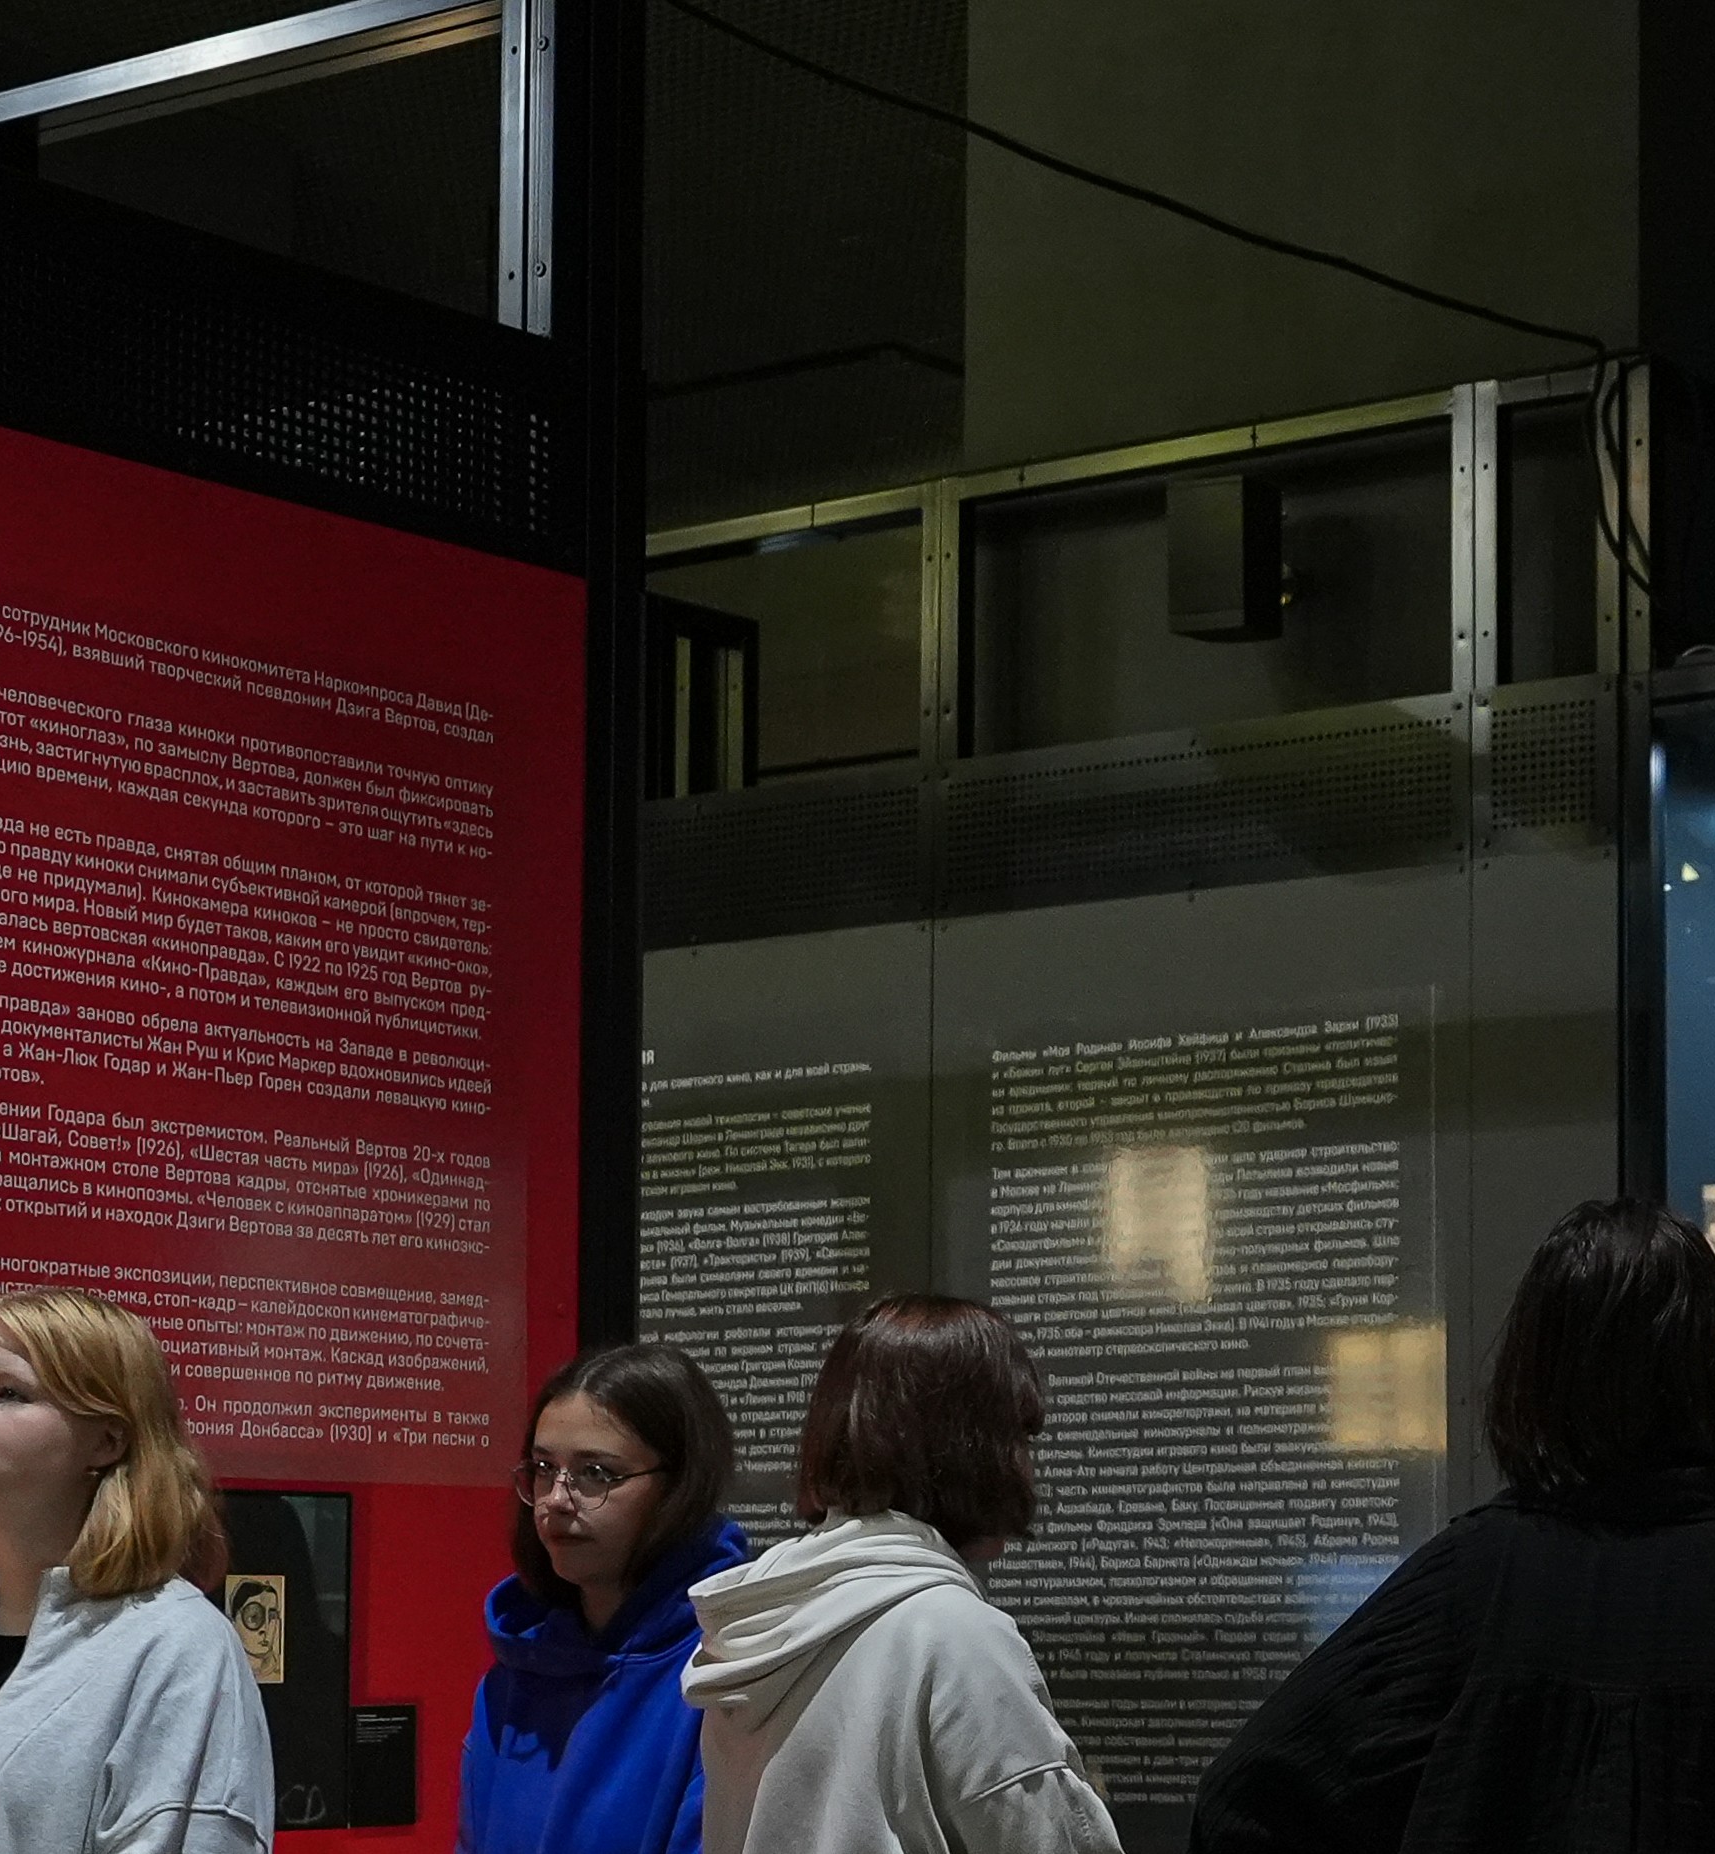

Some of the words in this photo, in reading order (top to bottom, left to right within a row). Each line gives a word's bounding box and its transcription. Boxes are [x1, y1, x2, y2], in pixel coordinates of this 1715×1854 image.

[1, 605, 90, 636] сотрудник
[94, 622, 198, 659] Московского
[201, 649, 310, 683] кинокомитета
[314, 669, 413, 706] Наркомпроса
[415, 692, 462, 718] Давид
[72, 643, 144, 670] взявший
[148, 660, 241, 691] творческий
[246, 681, 331, 710] псевдоним
[335, 696, 380, 720] Дзига
[384, 706, 439, 734] Вертов,
[443, 722, 493, 743] создал
[76, 1005, 135, 1025] заново
[141, 1012, 198, 1033] обрела
[204, 1022, 310, 1048] актуальность
[315, 1038, 333, 1051] на
[338, 1037, 393, 1061] Западе
[398, 1049, 407, 1061] в
[412, 1051, 490, 1072] революци-
[114, 1266, 215, 1288] экспозиции,
[219, 1274, 337, 1295] перспективное
[340, 1284, 435, 1304] совмещение,
[439, 1292, 489, 1308] замед-
